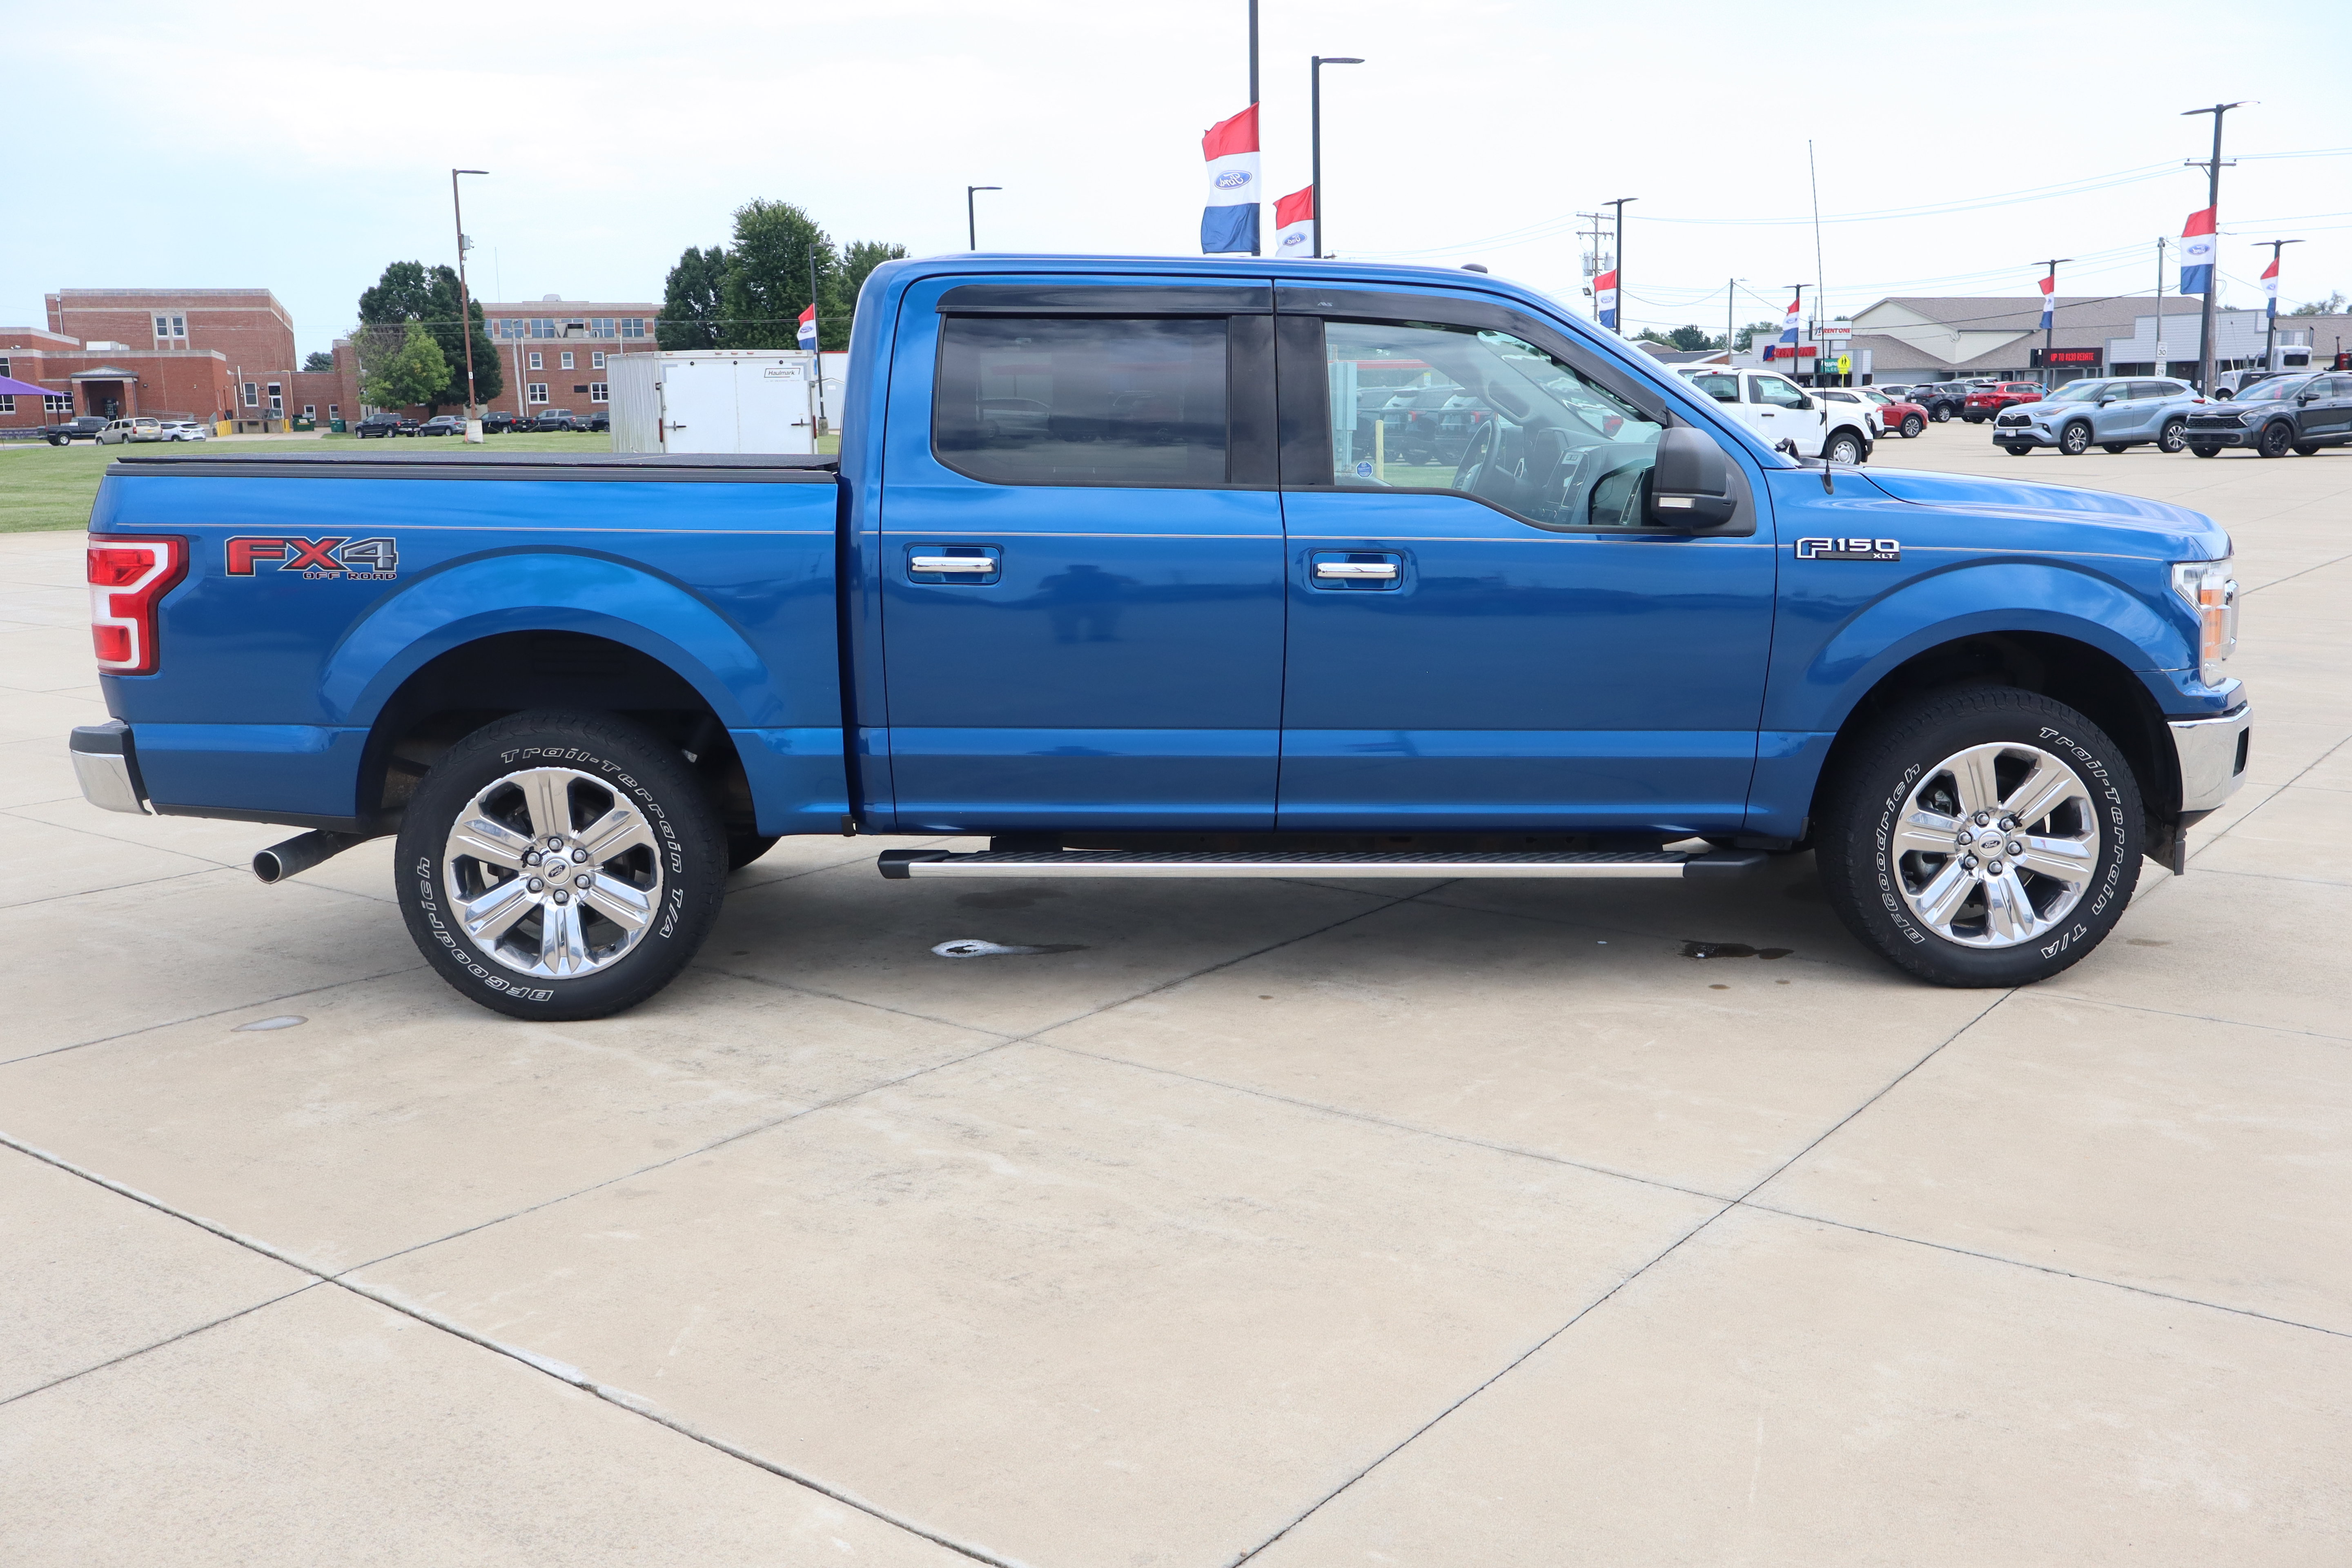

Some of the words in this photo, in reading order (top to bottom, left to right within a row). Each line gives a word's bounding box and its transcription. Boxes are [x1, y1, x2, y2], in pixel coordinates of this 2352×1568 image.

[224, 535, 398, 577] FX4
[1795, 537, 1900, 559] F150
[303, 572, 340, 580] OFF
[347, 572, 397, 580] ROAD
[2040, 726, 2126, 916] Trail-Terrain
[501, 748, 682, 874] Trail-Terrain
[659, 889, 685, 939] T/A
[2041, 922, 2087, 960] T/A
